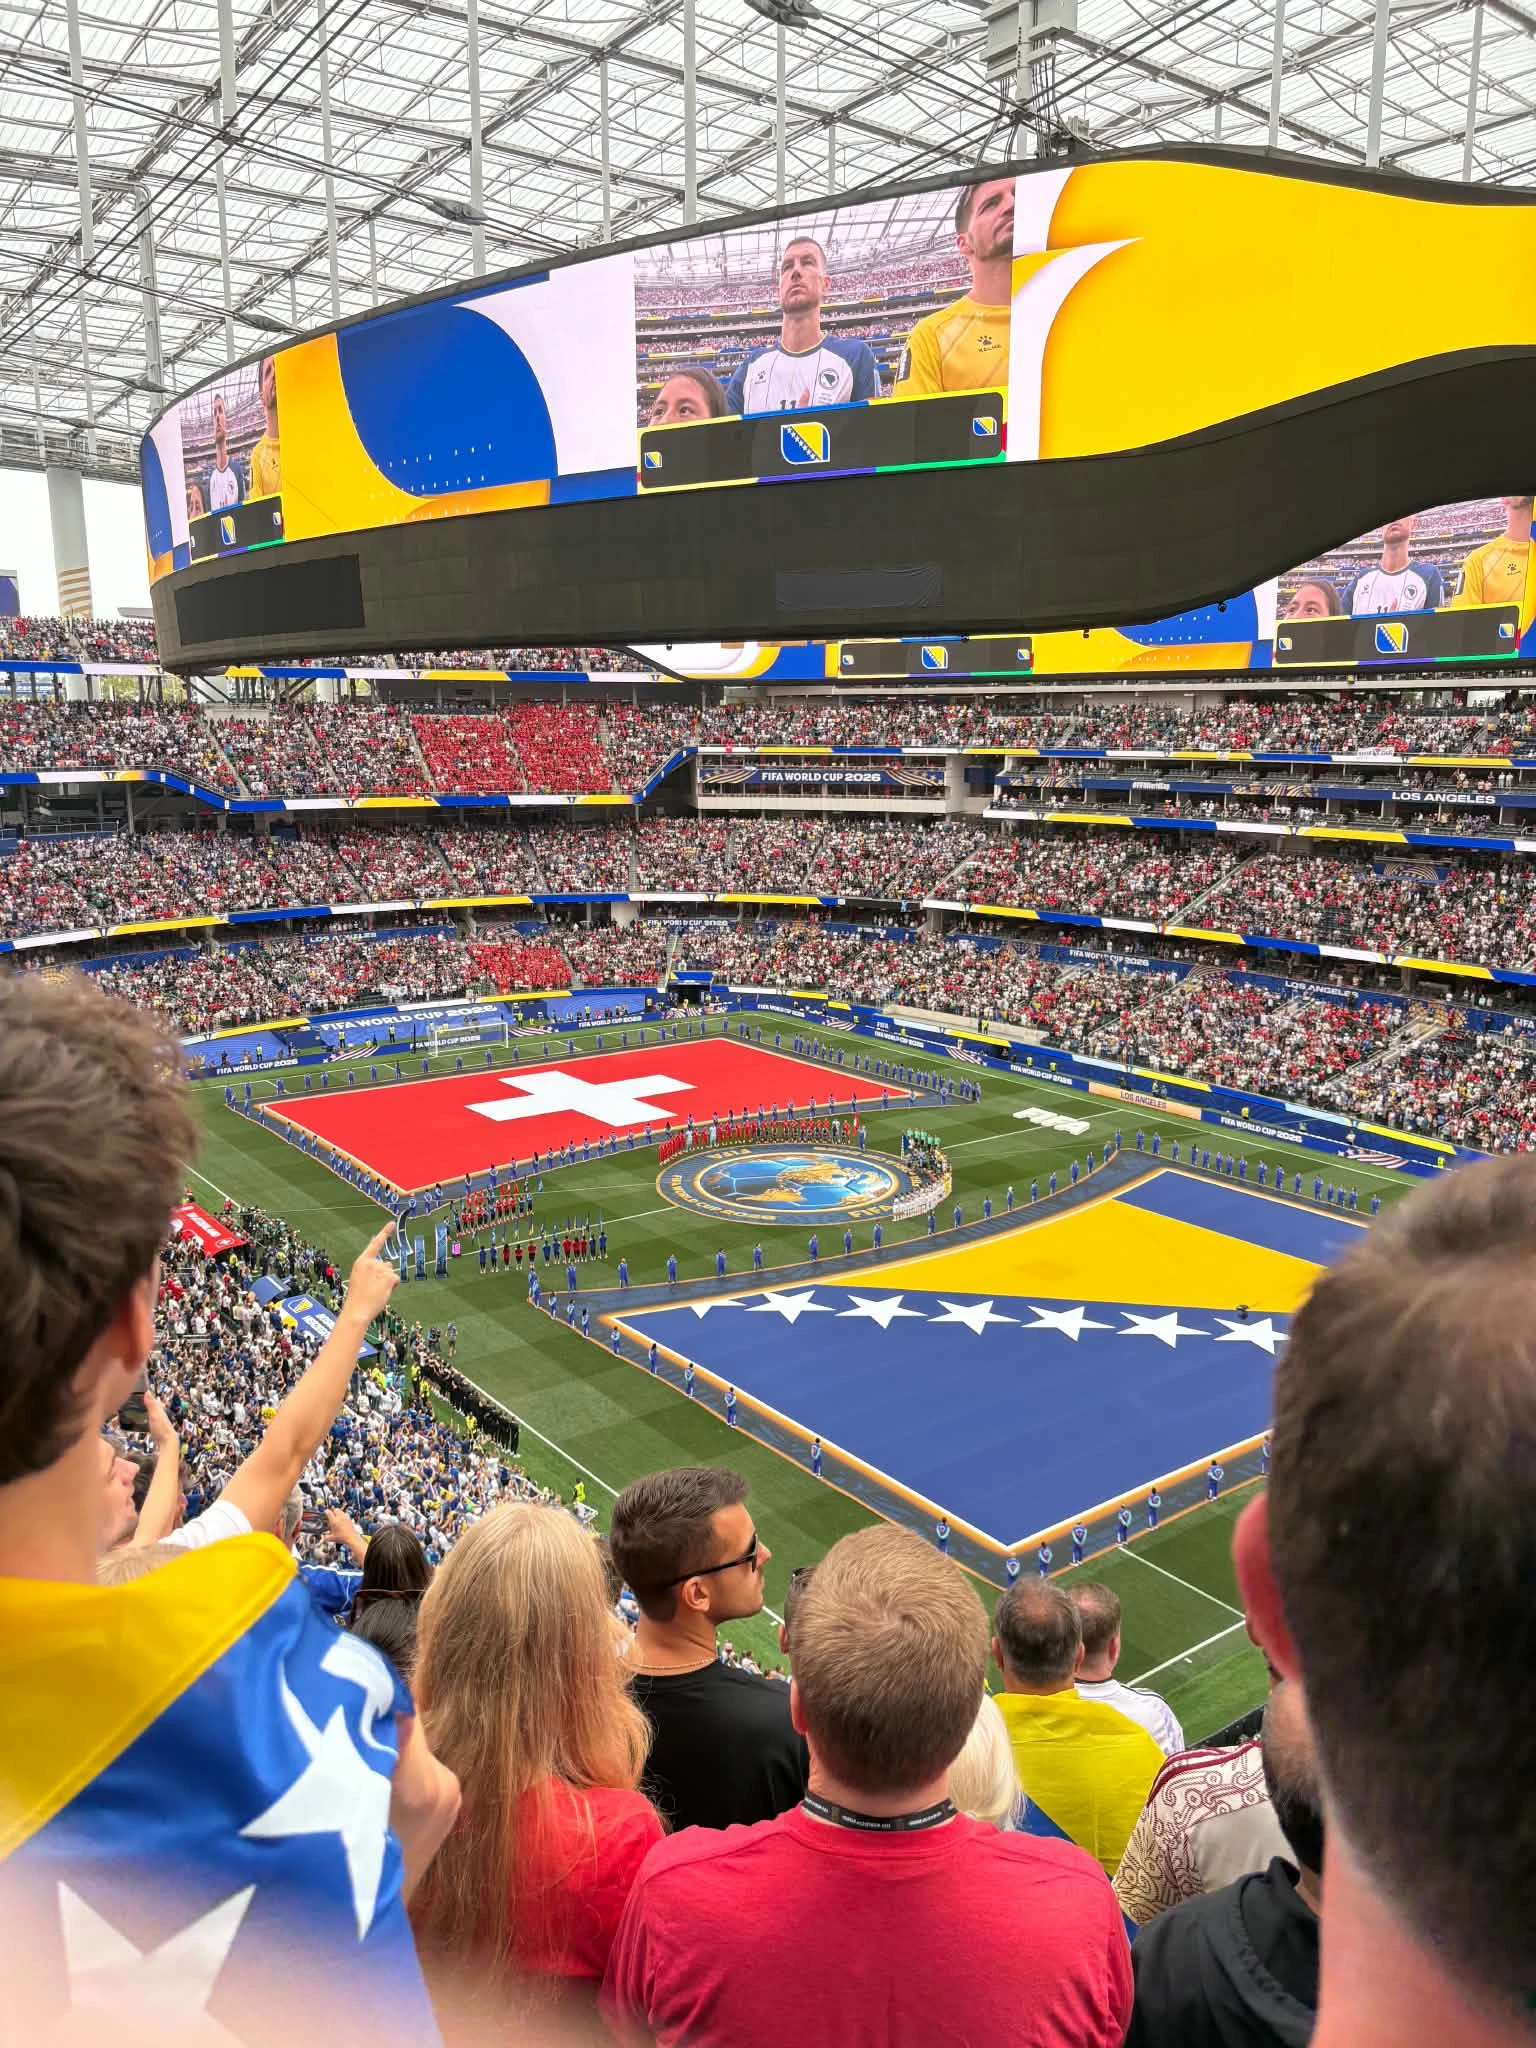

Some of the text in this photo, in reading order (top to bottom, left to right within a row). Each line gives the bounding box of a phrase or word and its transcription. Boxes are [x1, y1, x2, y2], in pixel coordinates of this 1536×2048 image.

[762, 772, 880, 782] FIFA WORLD CUP 2026
[1392, 791, 1496, 804] LOS ANGELES
[1070, 950, 1084, 958] FIFA
[1110, 954, 1124, 962] CUP
[1125, 956, 1149, 966] 2026
[1284, 980, 1360, 998] LOS ANGELES
[322, 1004, 498, 1031] FIFA WORLD CUP 2026
[884, 1032, 900, 1042] WORLD
[216, 1058, 298, 1076] FIFA WORLD CUP 2026
[1021, 1066, 1040, 1077] WORLD
[1041, 1070, 1052, 1080] CUP
[1053, 1075, 1073, 1086] 2026
[1120, 1090, 1167, 1109] LOS ANGELES
[1012, 1106, 1090, 1136] FIFA
[1220, 1116, 1303, 1143] FIFA WORLD CUP 2026
[848, 1204, 894, 1218] FIFA
